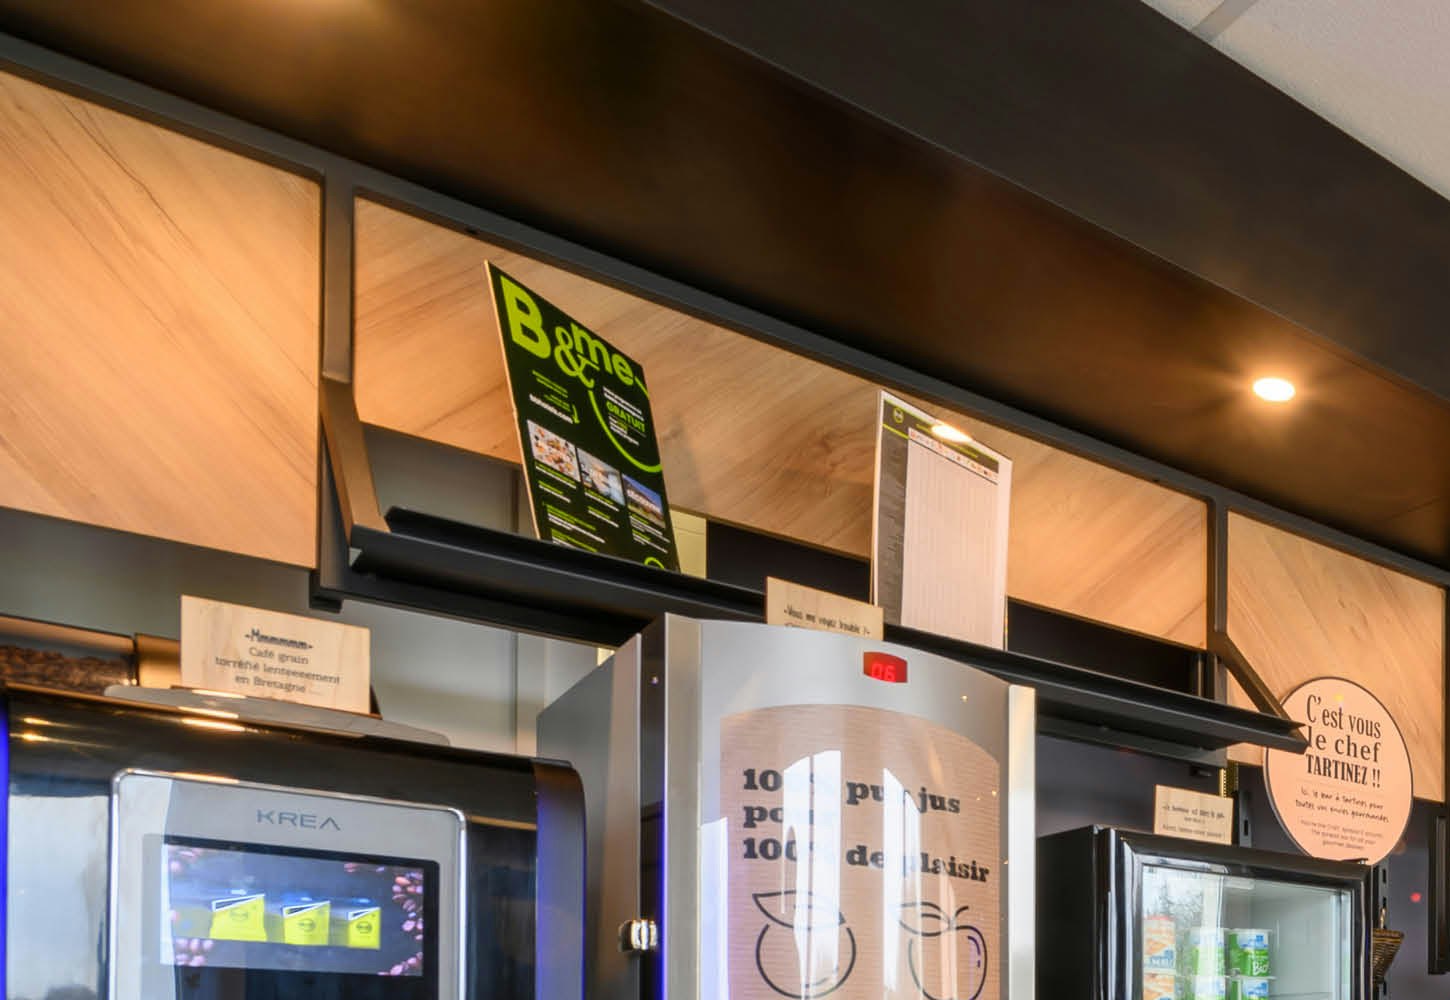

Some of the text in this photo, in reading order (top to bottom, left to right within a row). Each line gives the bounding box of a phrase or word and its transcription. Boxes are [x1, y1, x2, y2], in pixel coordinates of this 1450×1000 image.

[248, 646, 309, 664] Café grain
[234, 675, 306, 693] en Bretagne
[1306, 693, 1382, 739] C'est vous
[1307, 725, 1382, 763] le chef
[1305, 753, 1381, 789] TARTINEZ !!
[918, 786, 961, 814] jus
[256, 808, 341, 831] KREA
[846, 844, 884, 869] de
[902, 852, 990, 882] laisir
